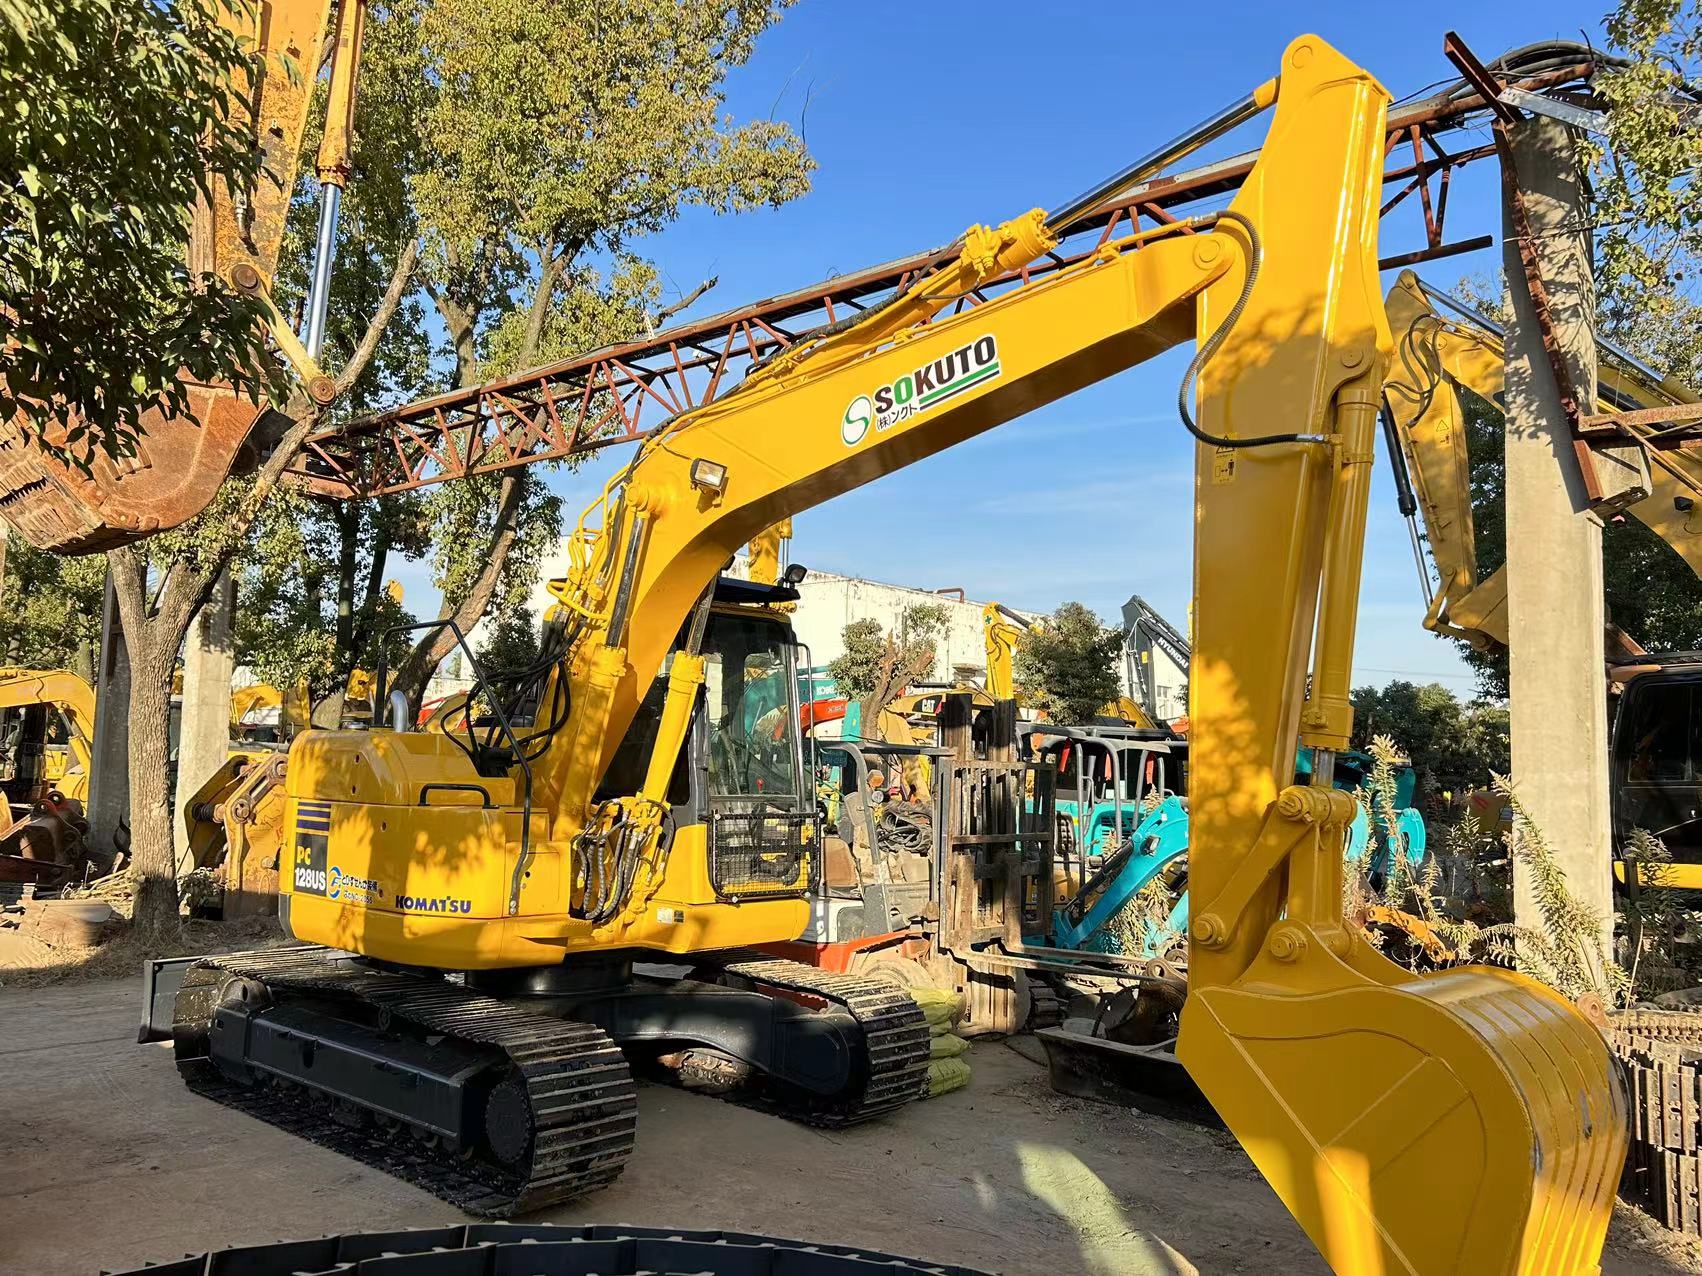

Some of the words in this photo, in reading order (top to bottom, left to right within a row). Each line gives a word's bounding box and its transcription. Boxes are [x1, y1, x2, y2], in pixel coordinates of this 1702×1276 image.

[874, 336, 996, 414] SOKUTO
[1157, 636, 1189, 669] HYUNDAI
[921, 698, 936, 713] CAT
[296, 845, 312, 866] PC
[294, 867, 326, 891] 128US
[395, 895, 472, 913] KOMATSU
